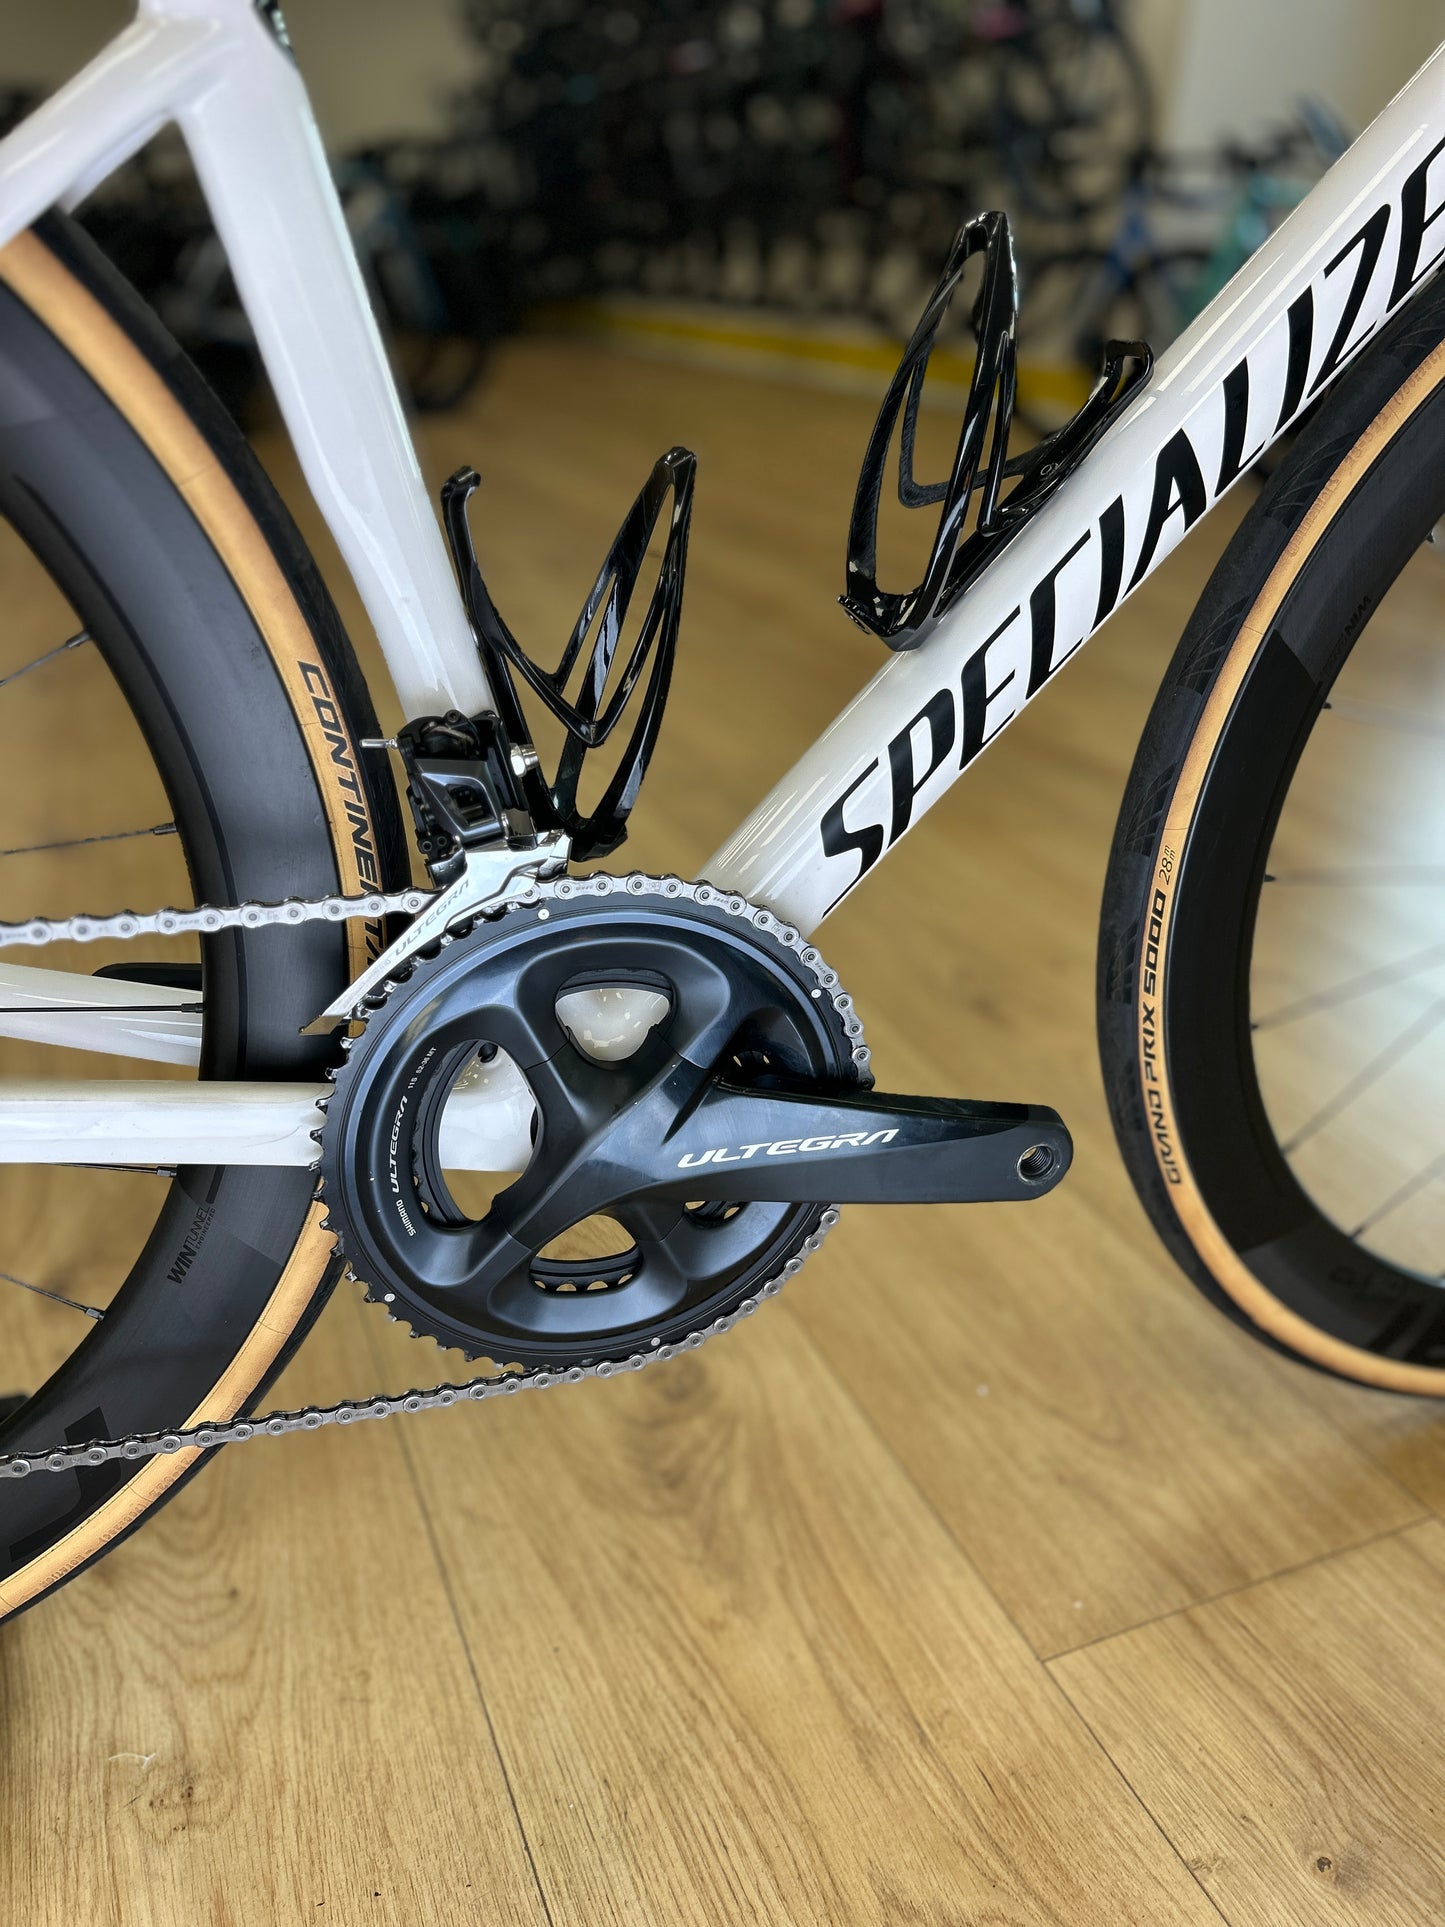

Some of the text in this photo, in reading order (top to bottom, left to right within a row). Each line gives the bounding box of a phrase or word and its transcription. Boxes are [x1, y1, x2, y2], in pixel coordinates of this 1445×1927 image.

[820, 137, 1445, 919] SPECIALIZE
[395, 879, 469, 956] ULTEGRA
[1144, 888, 1166, 996] 5000
[1143, 1001, 1158, 1082] PRIX
[388, 1095, 408, 1193] ULTEGRA
[677, 1128, 900, 1168] ULTEGRA
[1148, 1088, 1182, 1186] GRAND
[396, 1199, 417, 1237] SHIMANO
